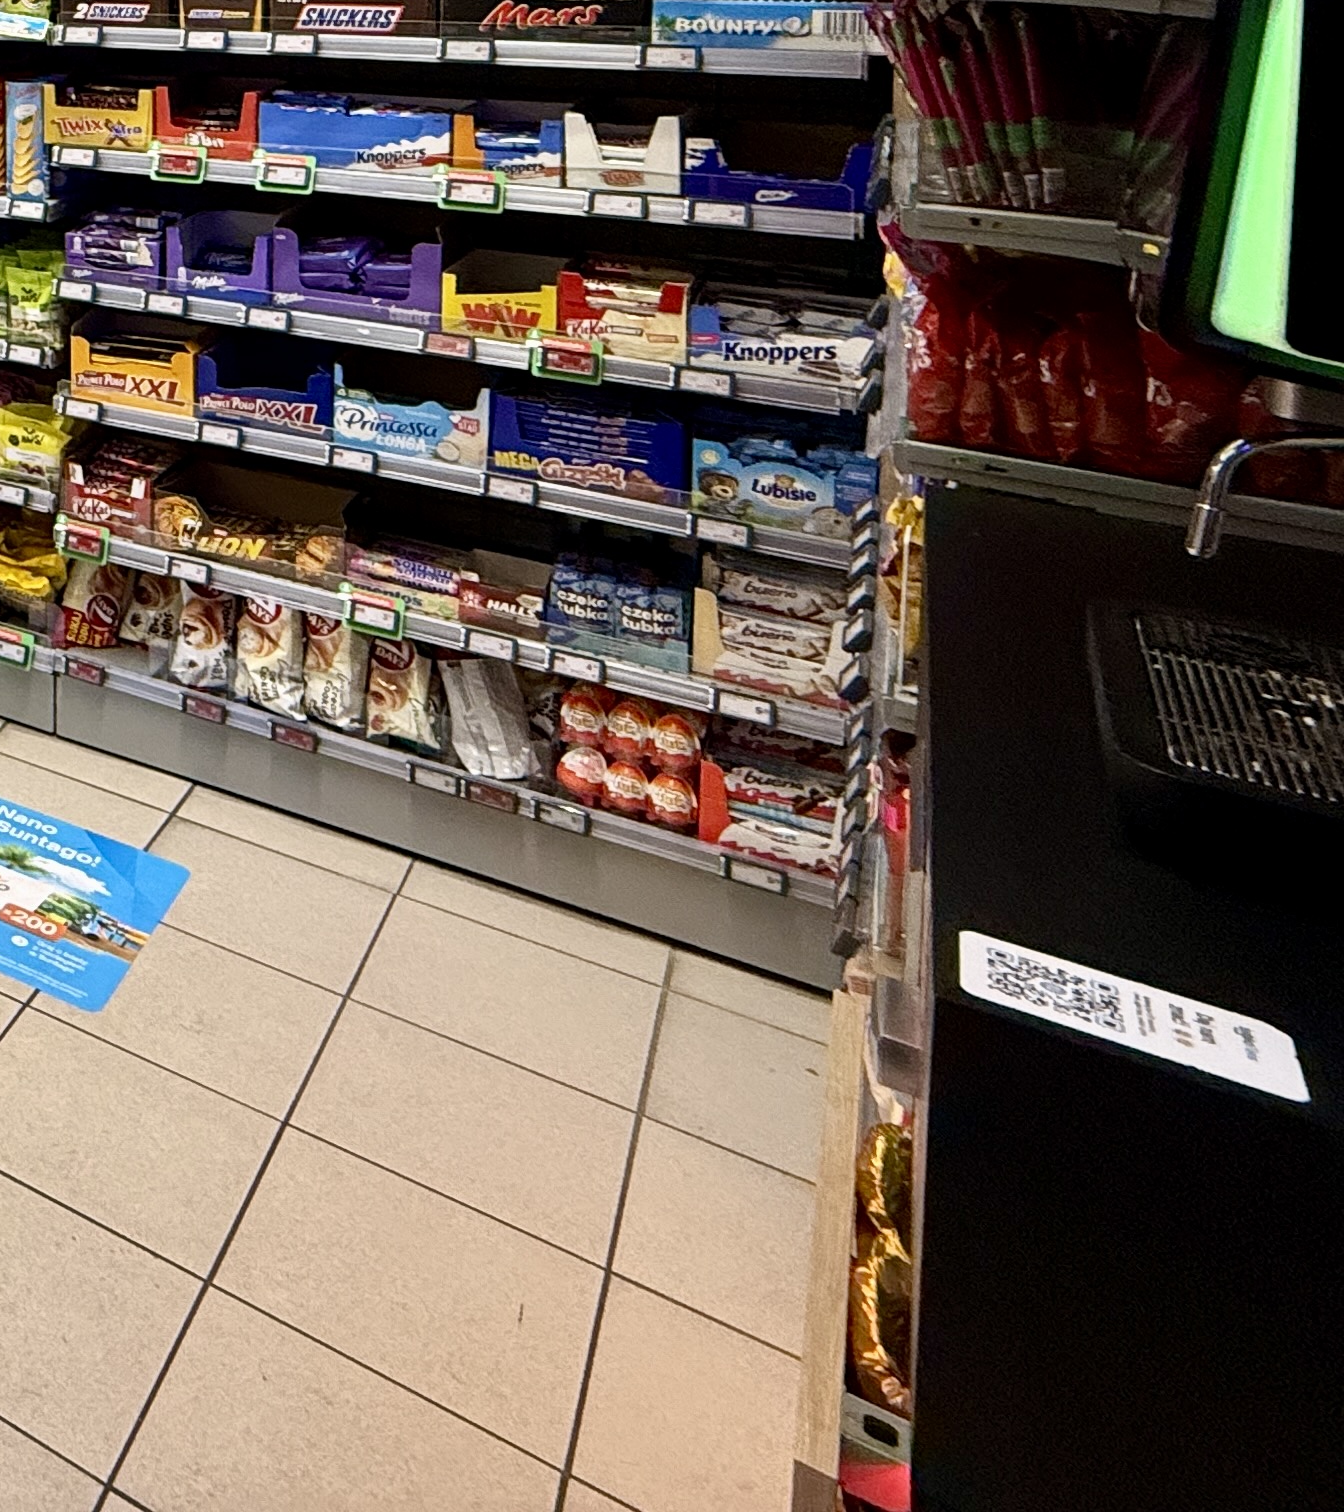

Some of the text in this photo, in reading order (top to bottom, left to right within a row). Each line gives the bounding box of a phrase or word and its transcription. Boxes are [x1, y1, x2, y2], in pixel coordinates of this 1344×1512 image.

[88, 5, 148, 20] SNICKERS
[300, 7, 397, 29] SNICKERS
[479, 0, 604, 31] Mars
[674, 17, 773, 34] BOUNTY
[356, 147, 427, 165] Knoppers
[488, 162, 545, 174] Knoppers
[723, 341, 837, 365] Knoppers
[126, 376, 185, 405] XXL
[258, 401, 326, 431] XXL
[345, 406, 438, 438] Princessa
[377, 433, 427, 452] LONGA
[494, 450, 540, 470] MEGA
[751, 478, 817, 503] Lubisie
[198, 536, 266, 560] LION
[487, 598, 538, 618] HALLS
[557, 590, 608, 608] czeko
[557, 602, 608, 620] tubka
[621, 605, 676, 623] czeko
[621, 617, 677, 635] tubka
